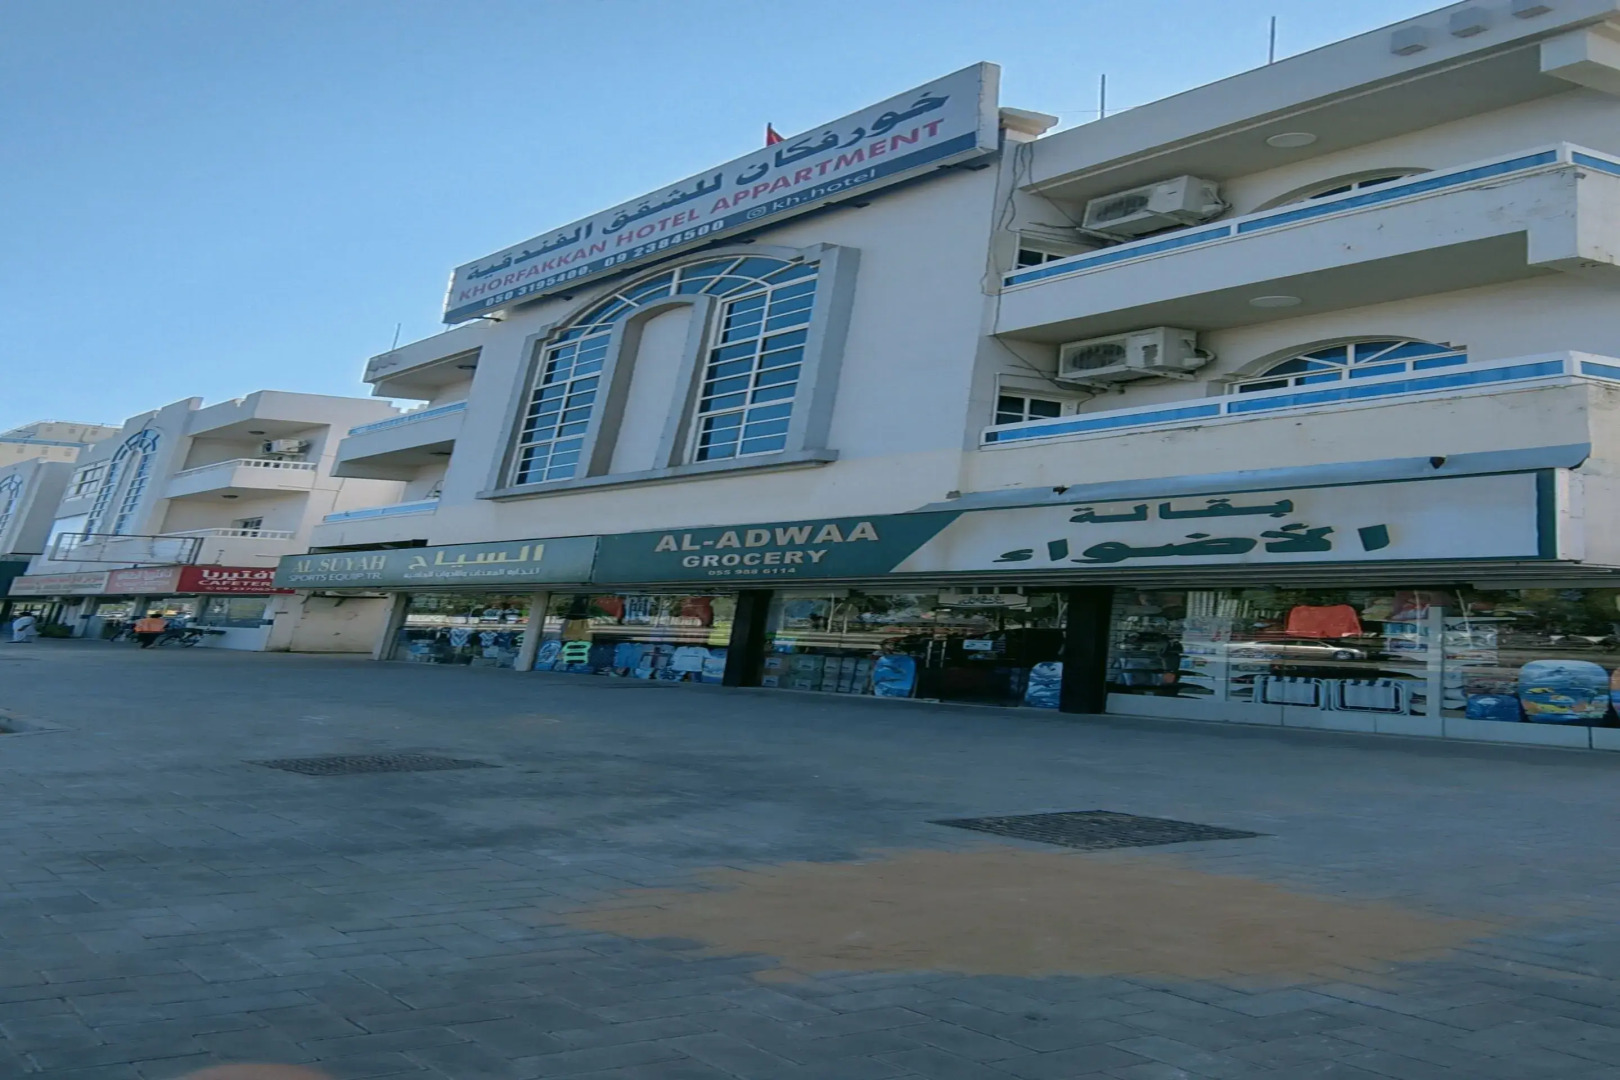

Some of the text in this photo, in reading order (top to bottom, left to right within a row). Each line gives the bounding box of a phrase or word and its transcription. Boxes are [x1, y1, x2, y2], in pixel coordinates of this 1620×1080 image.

[466, 92, 950, 280] خورفكان للشقق الفندقية
[771, 168, 876, 212] kh.hotel
[459, 118, 944, 301] KHORFAKKAN HOTEL APPARTMENT
[485, 290, 514, 307] 050
[603, 253, 627, 267] 09
[633, 220, 725, 257] 2384500
[1069, 498, 1294, 524] بقالة
[654, 521, 879, 552] AL-ADWAA
[992, 523, 1391, 564] الأضواء
[291, 555, 387, 573] AL SUYAH
[682, 550, 828, 568] GROCERY
[201, 569, 276, 581] افتيريا
[288, 573, 328, 582] SPORTS
